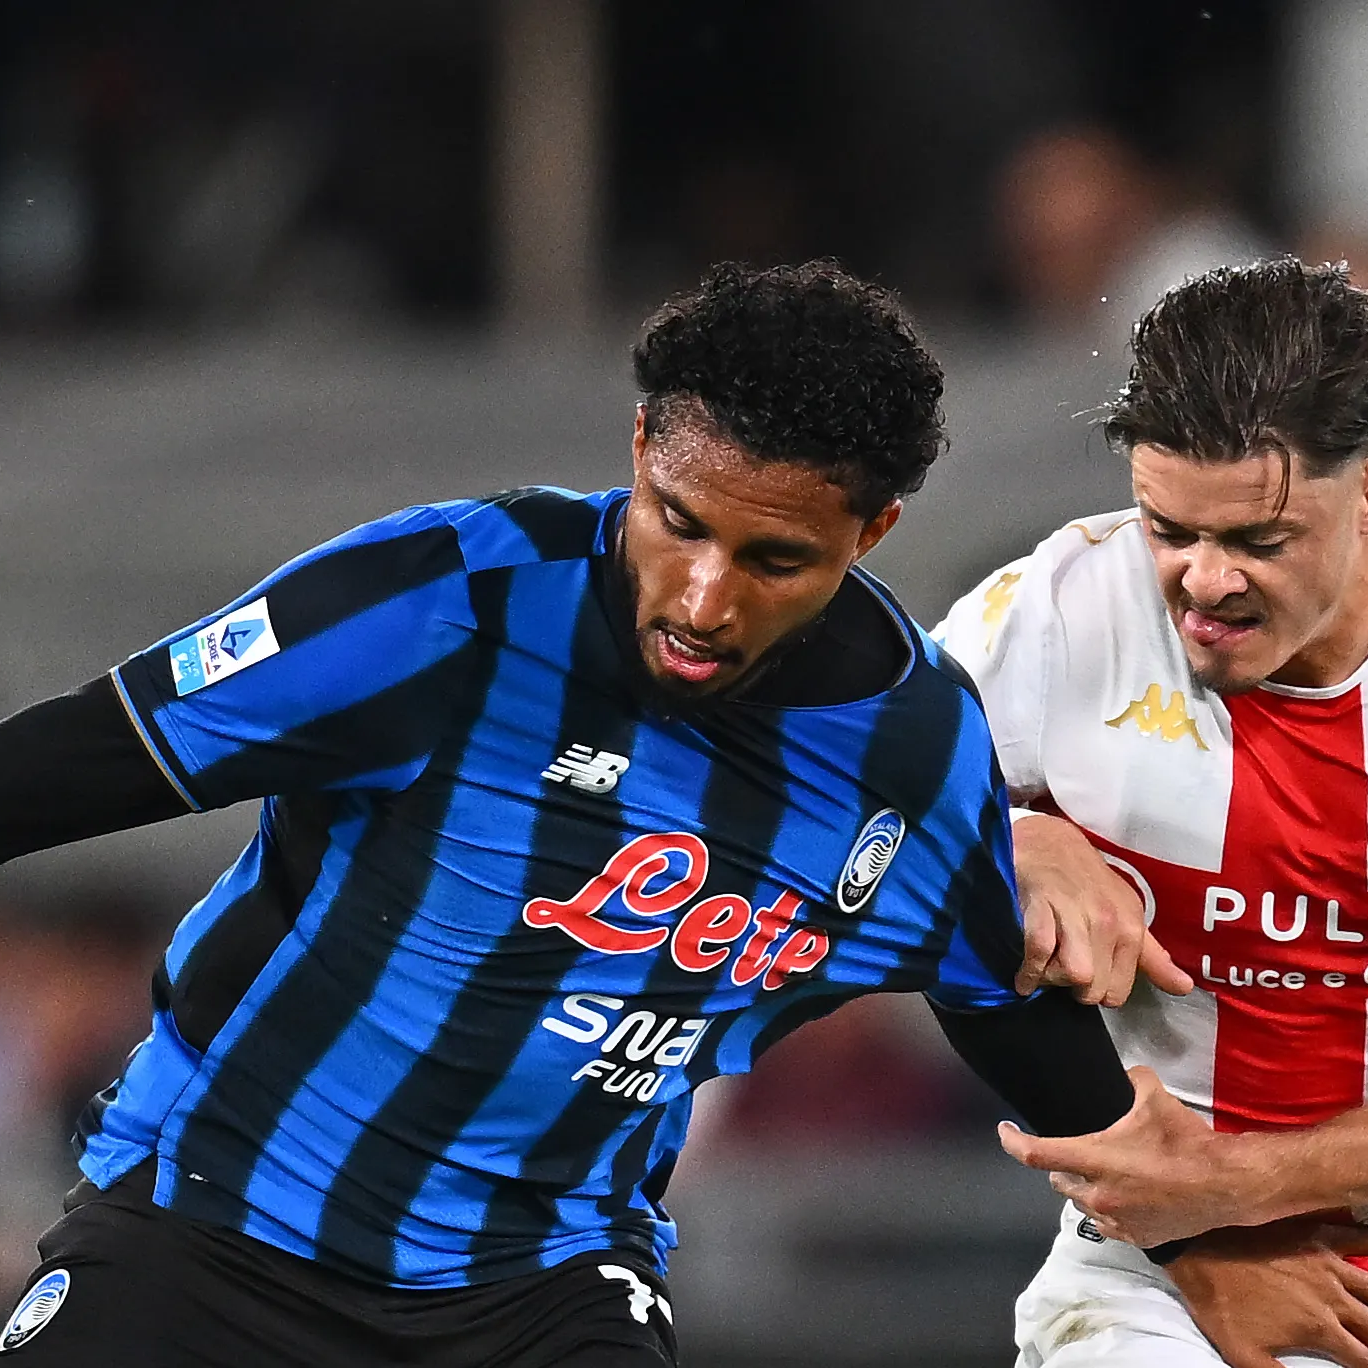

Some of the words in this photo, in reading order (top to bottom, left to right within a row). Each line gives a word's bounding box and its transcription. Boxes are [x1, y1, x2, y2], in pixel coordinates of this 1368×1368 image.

[206, 632, 220, 662] SERIE
[212, 664, 222, 673] A
[522, 831, 830, 990] Lete
[1201, 954, 1306, 990] Luce
[1322, 971, 1347, 988] e
[571, 1059, 667, 1103] FUN
